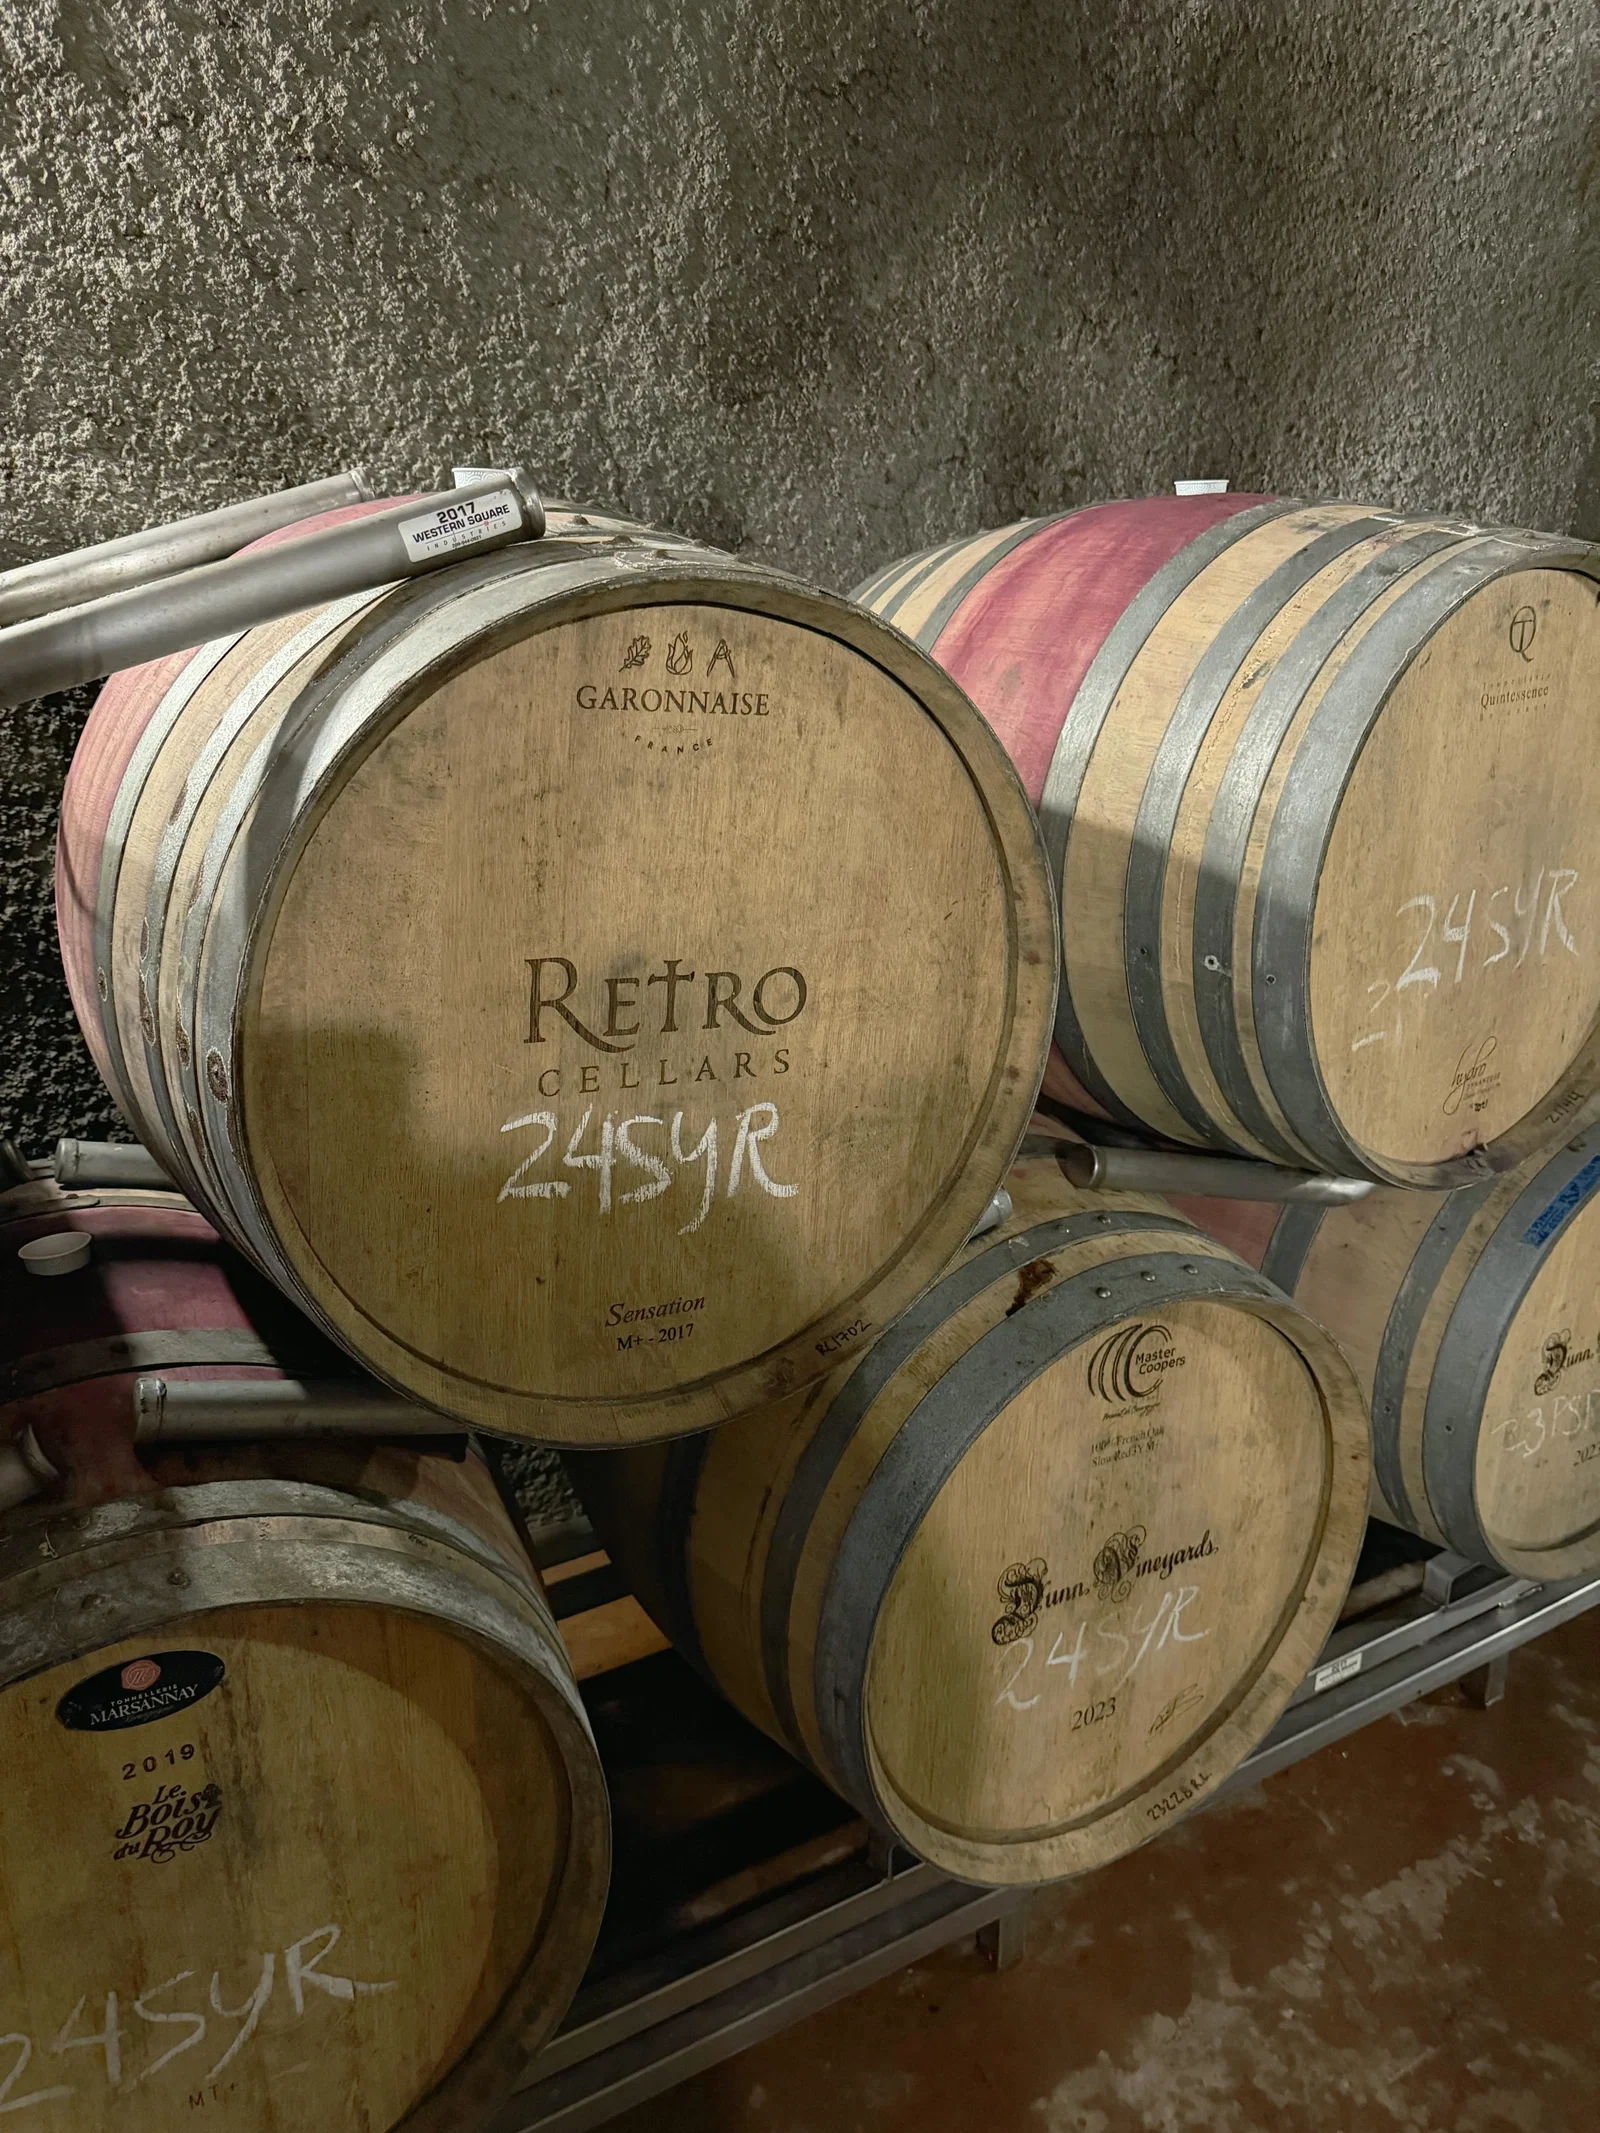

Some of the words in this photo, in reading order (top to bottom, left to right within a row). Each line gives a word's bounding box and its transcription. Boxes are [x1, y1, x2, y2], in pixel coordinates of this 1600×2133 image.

[412, 520, 466, 543] WESTERN
[468, 504, 511, 526] SQUARE
[436, 501, 476, 524] 2017
[427, 520, 507, 552] INDUSTRIES
[576, 684, 770, 716] GARONNAISE
[1480, 686, 1549, 710] Quintessence
[634, 735, 714, 755] FRANCE
[537, 1049, 790, 1097] CELLARS
[605, 1296, 705, 1328] Sensation
[659, 1323, 695, 1344] 2017
[1135, 1347, 1176, 1366] Master
[1139, 1356, 1186, 1376] Coopers
[90, 1684, 198, 1726] MARSANNAY
[1071, 1697, 1117, 1732] 2023
[121, 1743, 195, 1780] 2019
[113, 1842, 141, 1861] du
